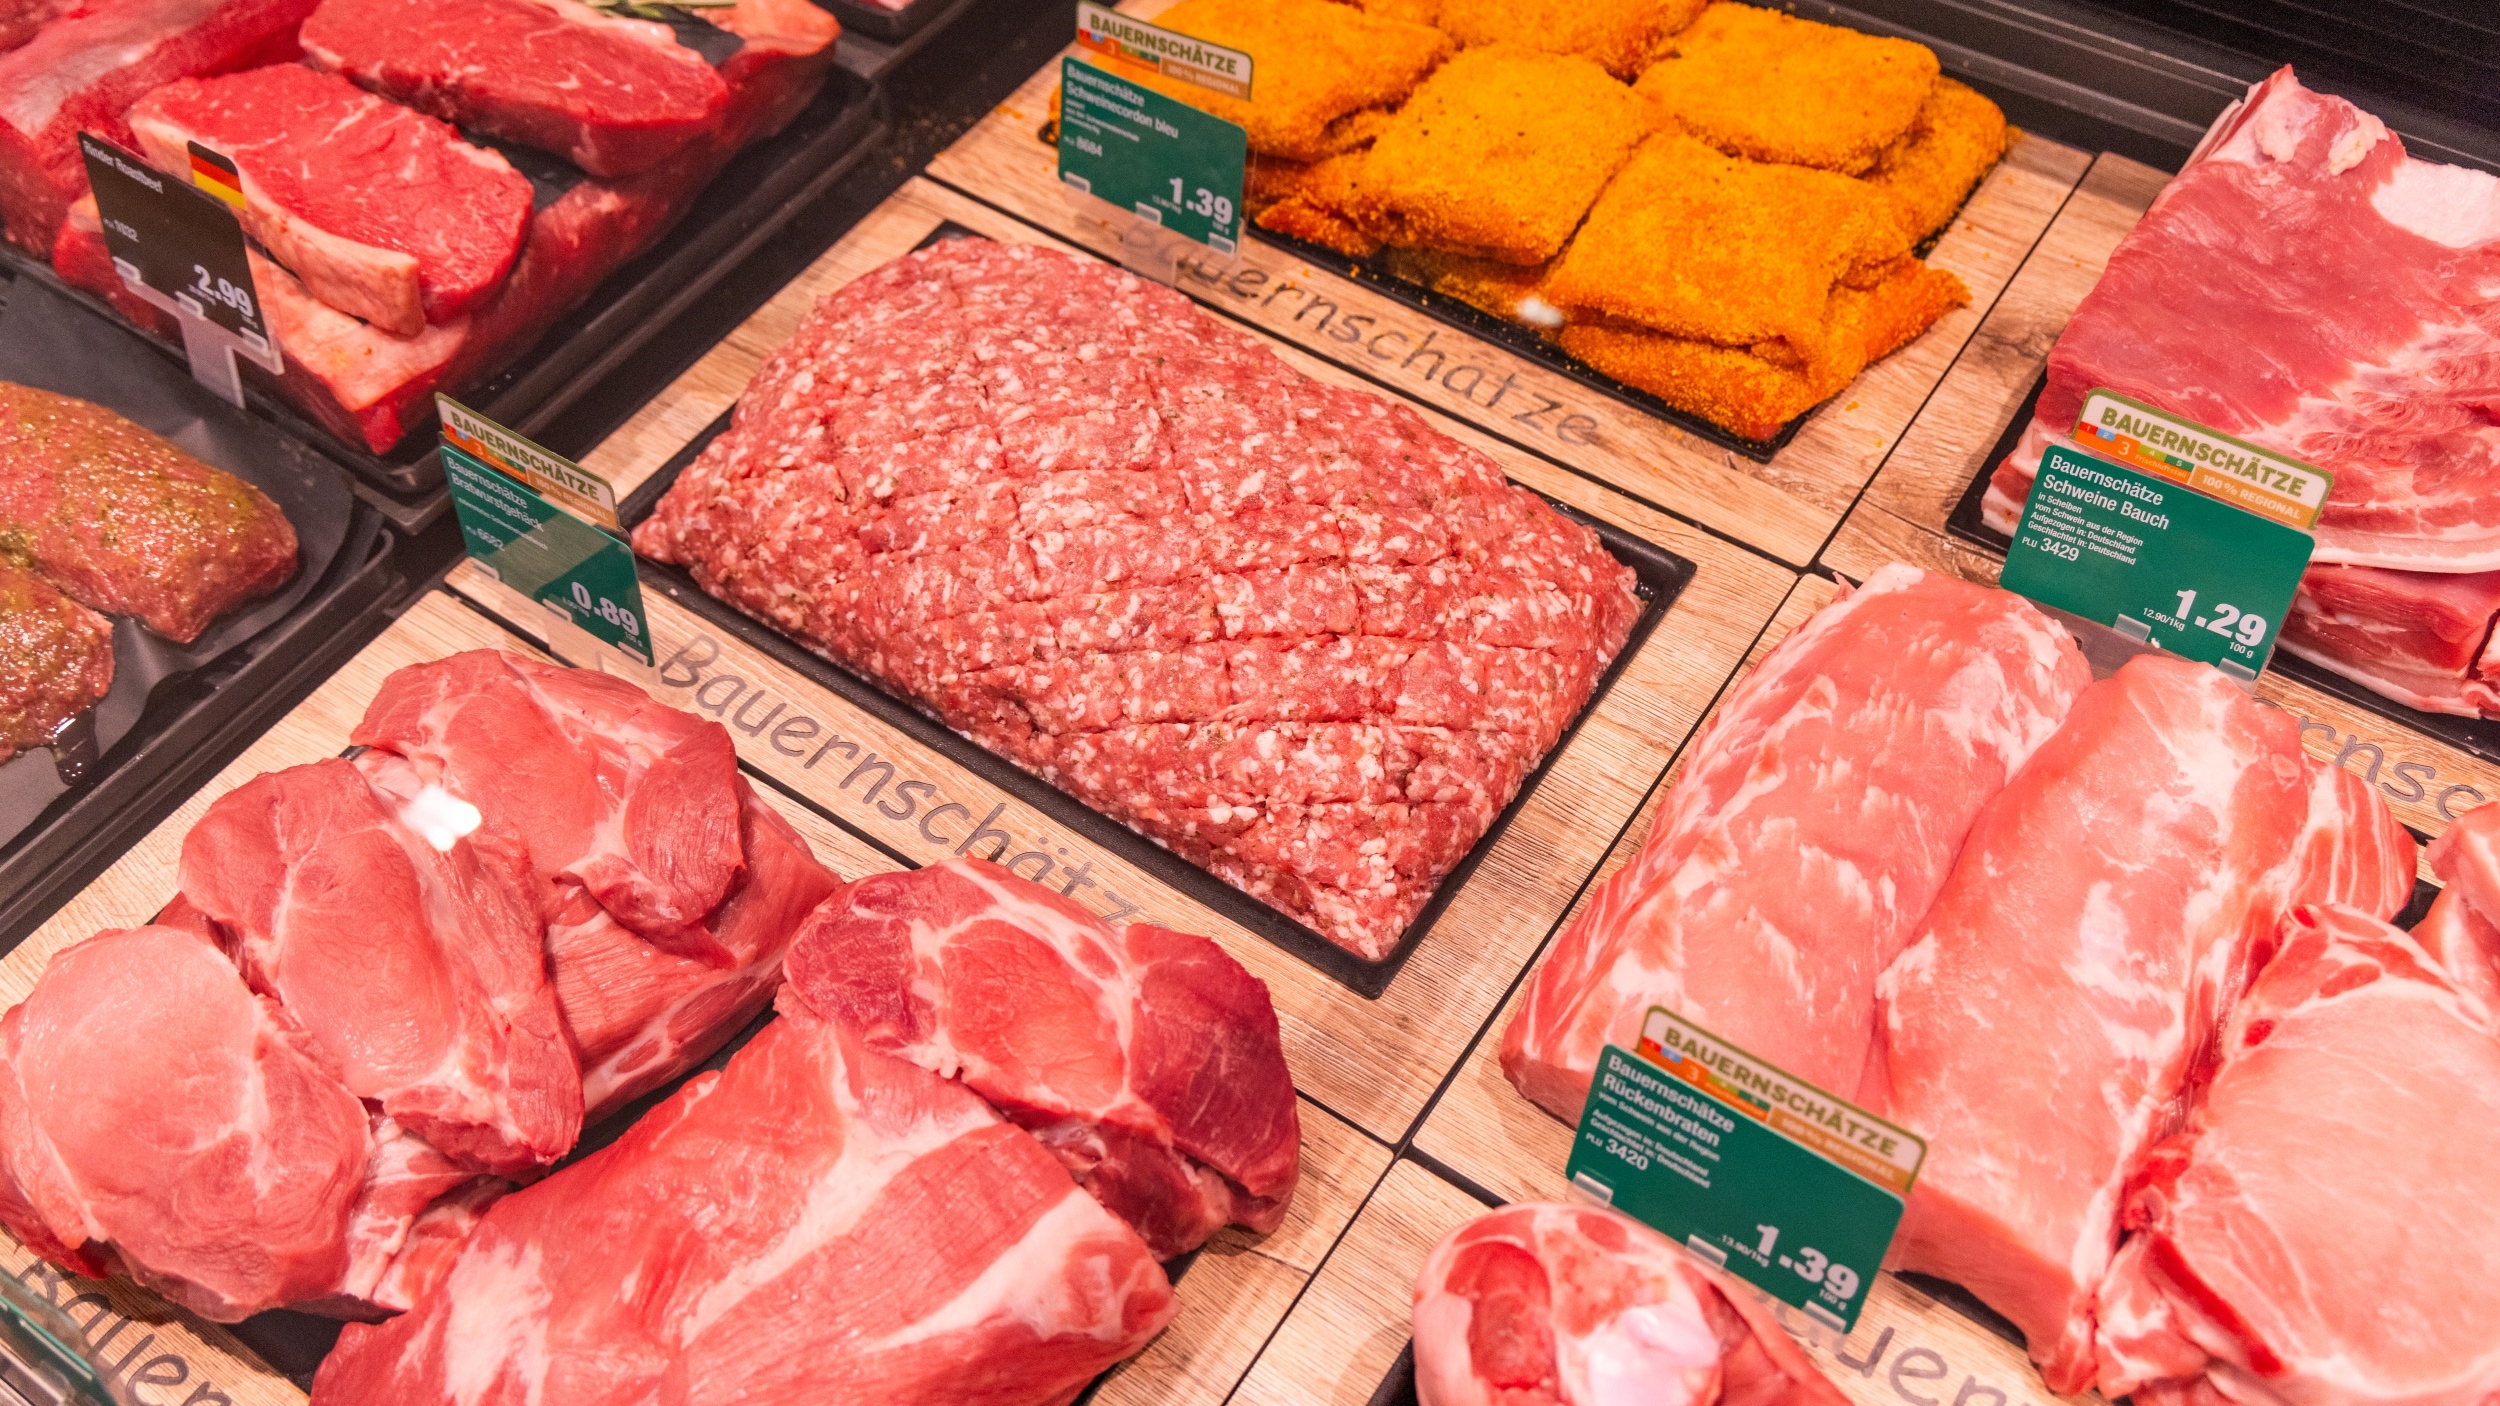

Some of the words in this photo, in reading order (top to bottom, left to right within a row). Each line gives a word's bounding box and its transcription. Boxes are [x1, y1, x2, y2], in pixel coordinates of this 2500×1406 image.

[1090, 14, 1237, 75] BAUERNSCHÄTZE
[1067, 63, 1145, 107] Bauernschätze
[1155, 117, 1179, 139] bleu
[1169, 177, 1233, 225] 1.39
[193, 264, 255, 318] 2.99
[451, 412, 600, 501] BAUERNSCHÄTZE
[2100, 407, 2308, 497] BAUERNSCHÄTZE
[2117, 441, 2131, 457] 3
[446, 456, 528, 509] Bauernschätze
[451, 471, 544, 533] Bratwurstgehäck
[2037, 492, 2046, 501] in
[2046, 495, 2083, 514] Scheiben
[2043, 474, 2117, 511] Schweine
[2120, 501, 2170, 530] Bauch
[2050, 454, 2164, 506] Bauernschätze
[2203, 475, 2222, 490] 100
[2240, 489, 2302, 520] REGIONAL
[2021, 536, 2038, 548] PLU
[2040, 537, 2080, 562] 3429
[2028, 520, 2076, 544] Geschlachtet
[2077, 538, 2087, 548] in:
[2088, 542, 2137, 566] Deutschland
[2030, 511, 2076, 534] Aufgezogen
[2076, 527, 2086, 537] in:
[2087, 531, 2136, 555] Deutschland
[2035, 503, 2051, 513] vom
[2052, 509, 2085, 526] Schwein
[2086, 521, 2101, 532] aus
[2101, 525, 2116, 536] der
[2116, 532, 2144, 547] Region
[571, 581, 639, 636] 0.89
[2143, 607, 2186, 632] 12.90/1kg
[2175, 589, 2267, 647] 1.29
[2229, 641, 2246, 655] 100
[2246, 650, 2254, 659] g
[660, 635, 1172, 930] Bauernschätz
[1602, 1072, 1721, 1148] Rückenbraten
[1608, 1054, 1735, 1134] Bauernschätze
[1664, 1026, 1898, 1157] BAUERNSCHÄTZE
[1605, 1138, 1649, 1171] 3420
[1618, 1101, 1656, 1127] Schwein
[1689, 1140, 1721, 1162] Region
[1656, 1153, 1711, 1189] Deutschland
[1756, 1224, 1860, 1300] 1.39
